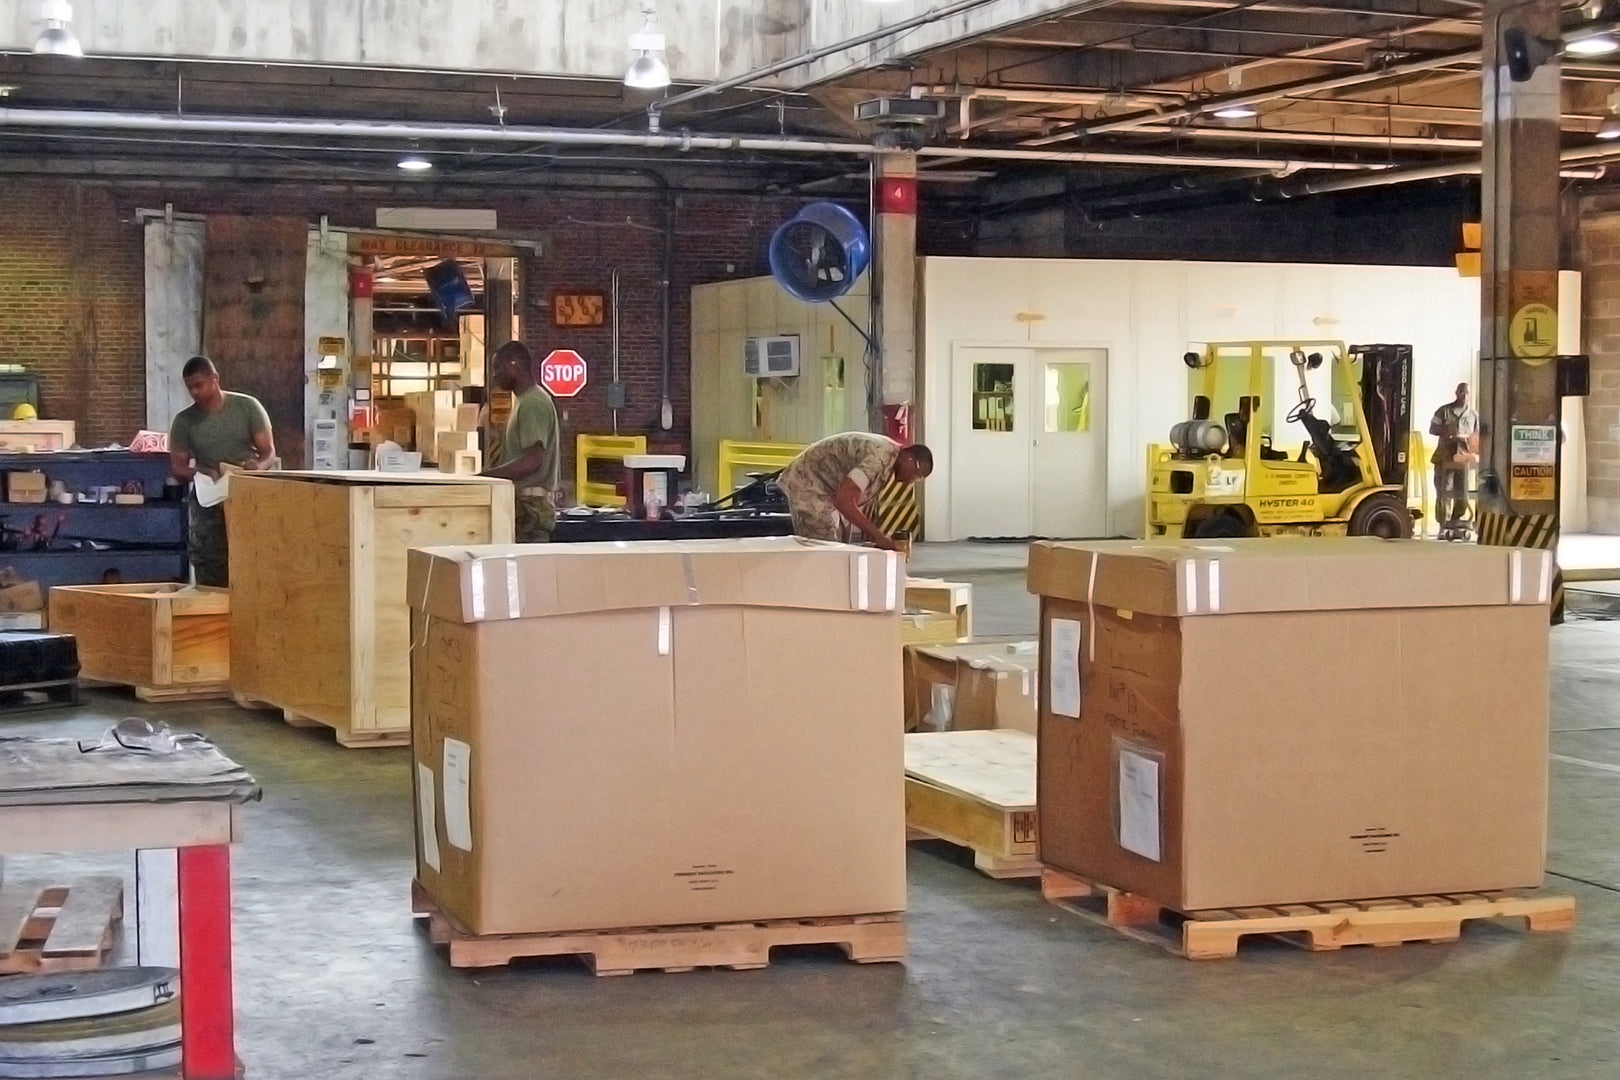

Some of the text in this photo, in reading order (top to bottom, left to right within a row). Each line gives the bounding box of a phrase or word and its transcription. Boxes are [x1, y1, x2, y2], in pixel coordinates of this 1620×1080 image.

[360, 239, 386, 251] MAX
[395, 239, 463, 254] CLEARANCE
[544, 364, 584, 382] STOP
[1518, 430, 1549, 440] THINK
[1513, 466, 1553, 477] CAUTION
[1259, 498, 1315, 508] HYSTER 40
